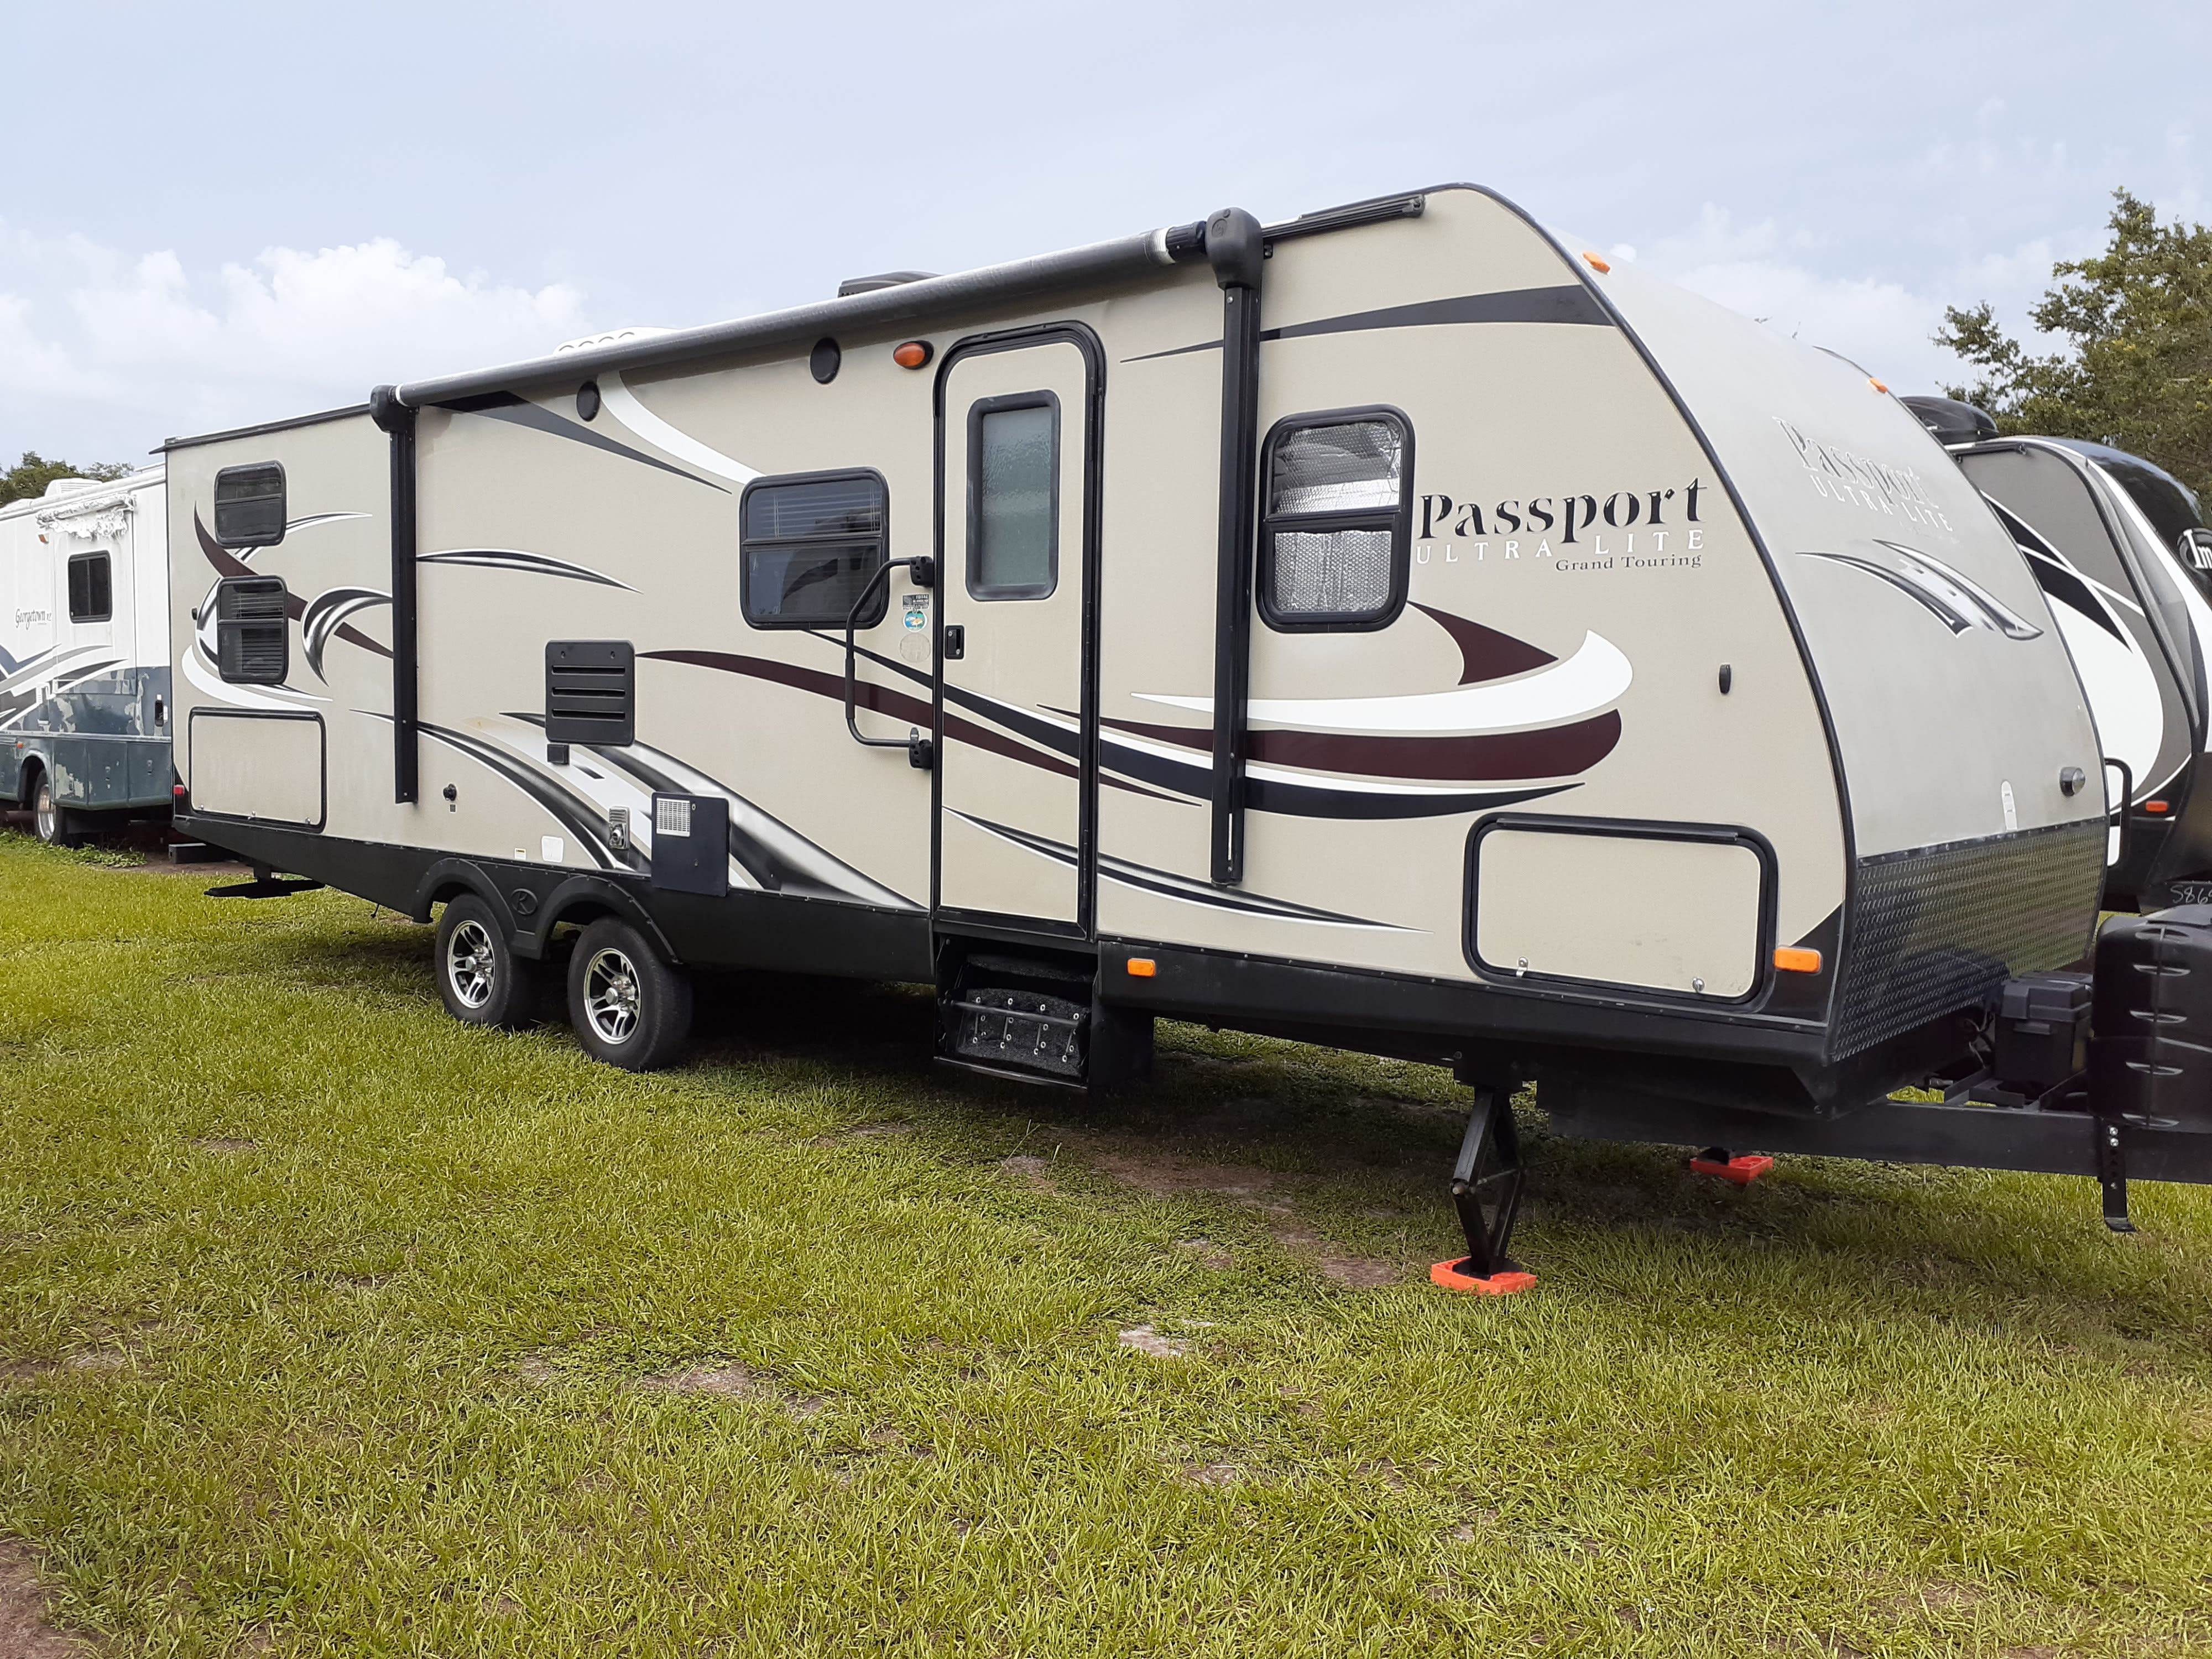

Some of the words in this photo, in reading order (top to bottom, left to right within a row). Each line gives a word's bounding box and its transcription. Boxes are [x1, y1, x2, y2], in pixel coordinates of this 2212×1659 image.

[1771, 416, 1939, 508] Passport
[1416, 477, 1708, 544] Passport
[1809, 474, 1893, 515] ULTRA
[1901, 502, 1953, 531] LITE
[1416, 538, 1553, 565] ULTRA
[1593, 529, 1704, 555] LITE
[1555, 556, 1614, 571] Grand
[1621, 554, 1702, 570] Touring
[15, 608, 45, 630] Georgetown
